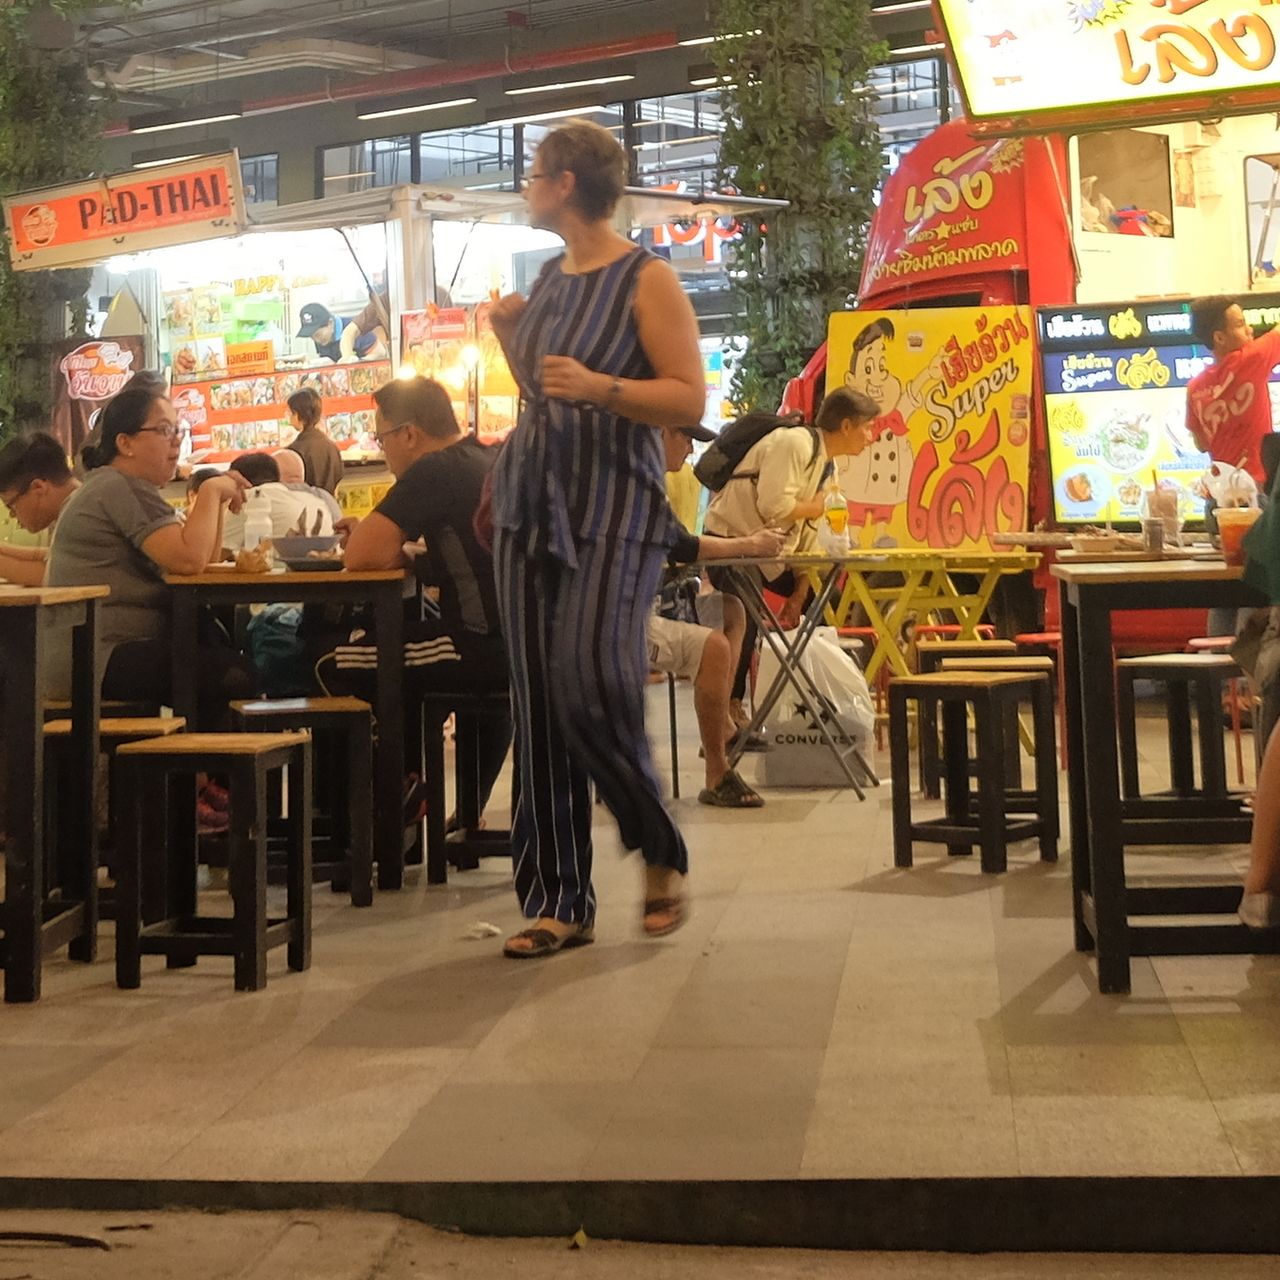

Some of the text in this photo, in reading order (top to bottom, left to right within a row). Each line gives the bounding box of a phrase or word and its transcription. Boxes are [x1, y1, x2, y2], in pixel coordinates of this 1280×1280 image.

[77, 173, 222, 230] PAD-THAI
[904, 146, 993, 223] เล้ง
[926, 357, 1019, 443] Super
[1061, 370, 1113, 392] Super
